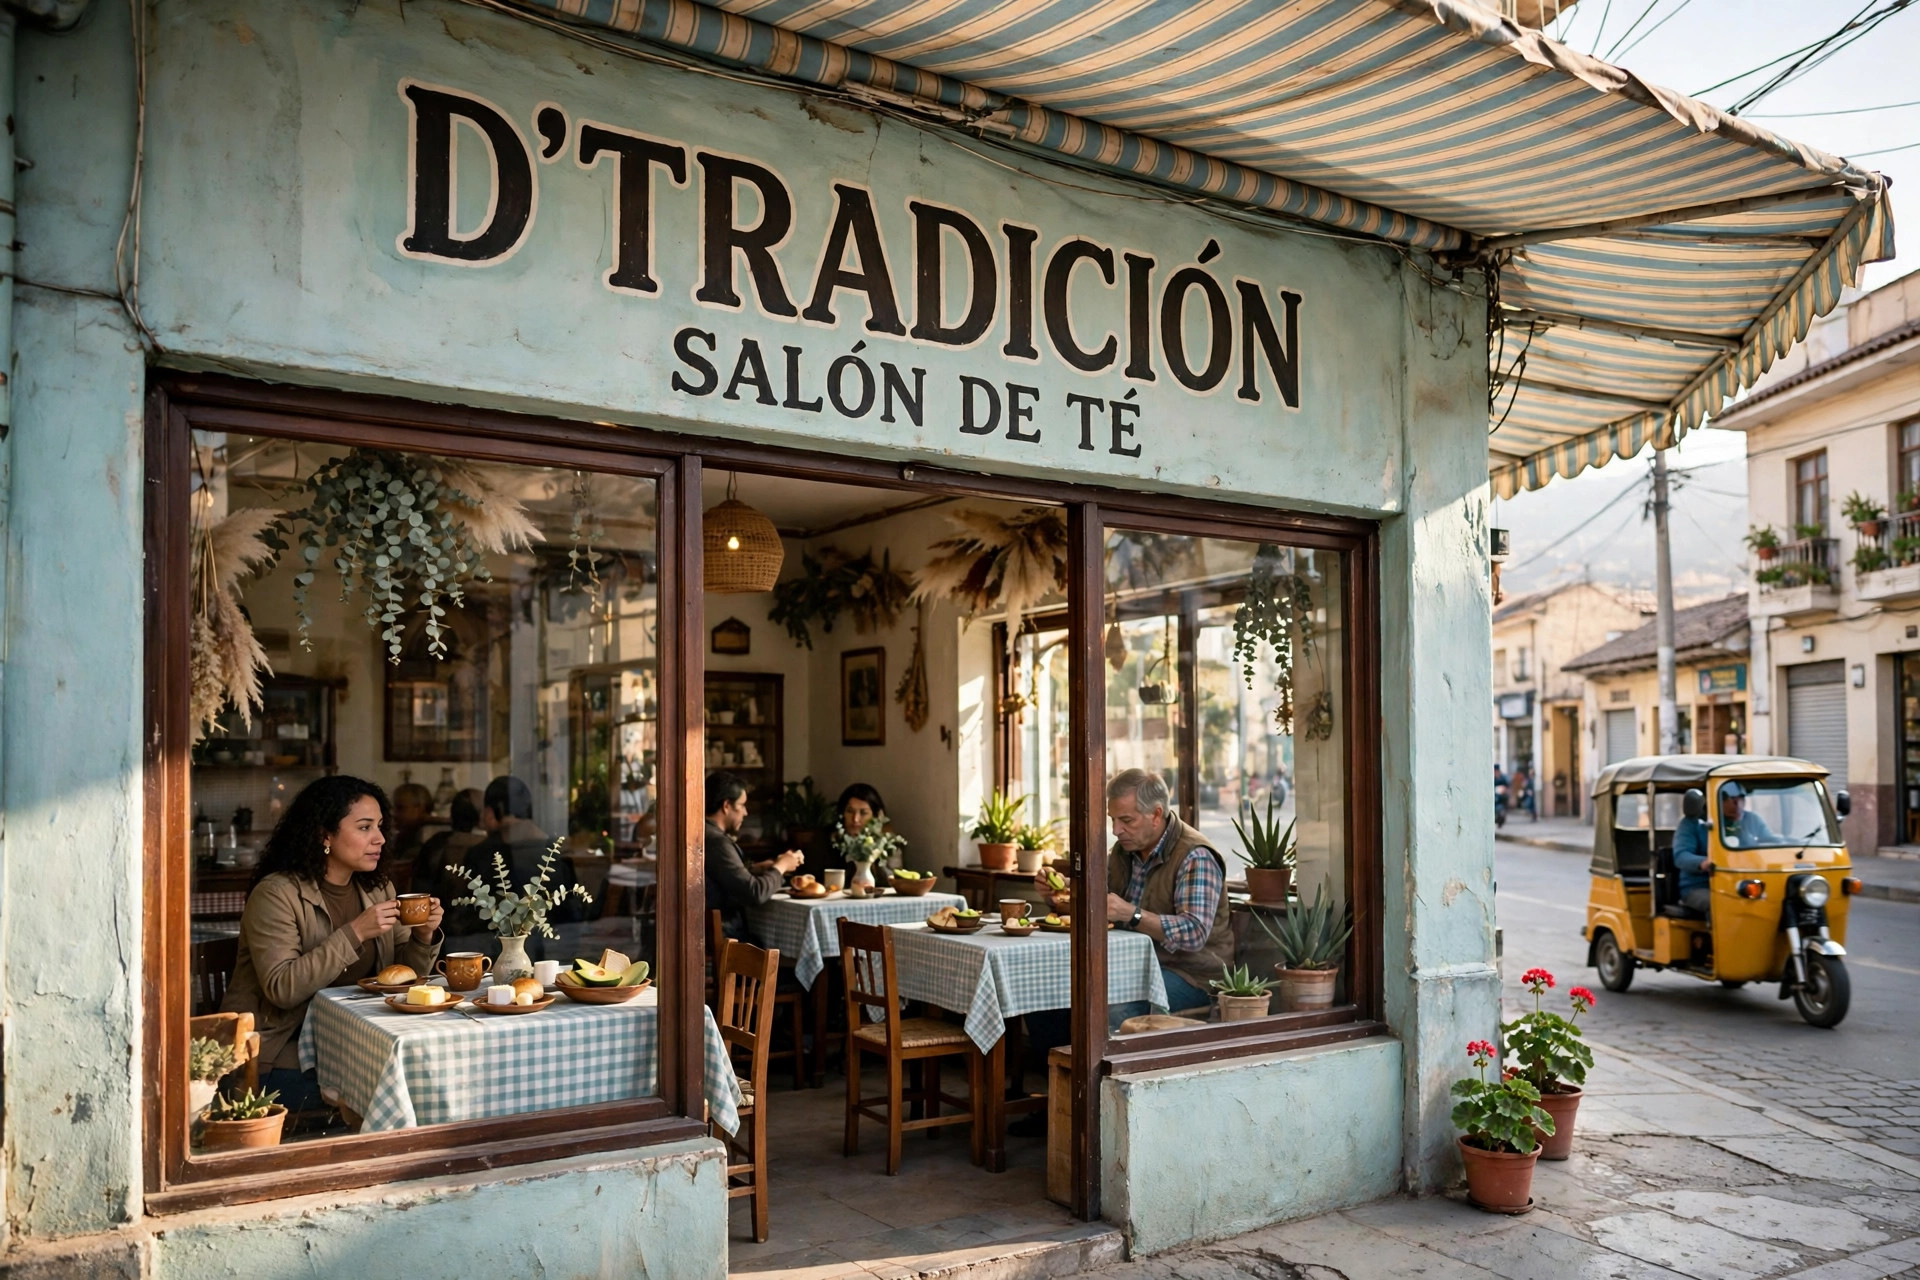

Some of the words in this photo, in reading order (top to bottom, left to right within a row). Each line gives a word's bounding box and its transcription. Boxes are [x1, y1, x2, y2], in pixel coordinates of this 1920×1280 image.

[400, 81, 1304, 410] D'TRADICIÓN
[671, 327, 927, 428] SALÓN
[958, 374, 1042, 444] DE
[1066, 387, 1142, 458] TÉ
